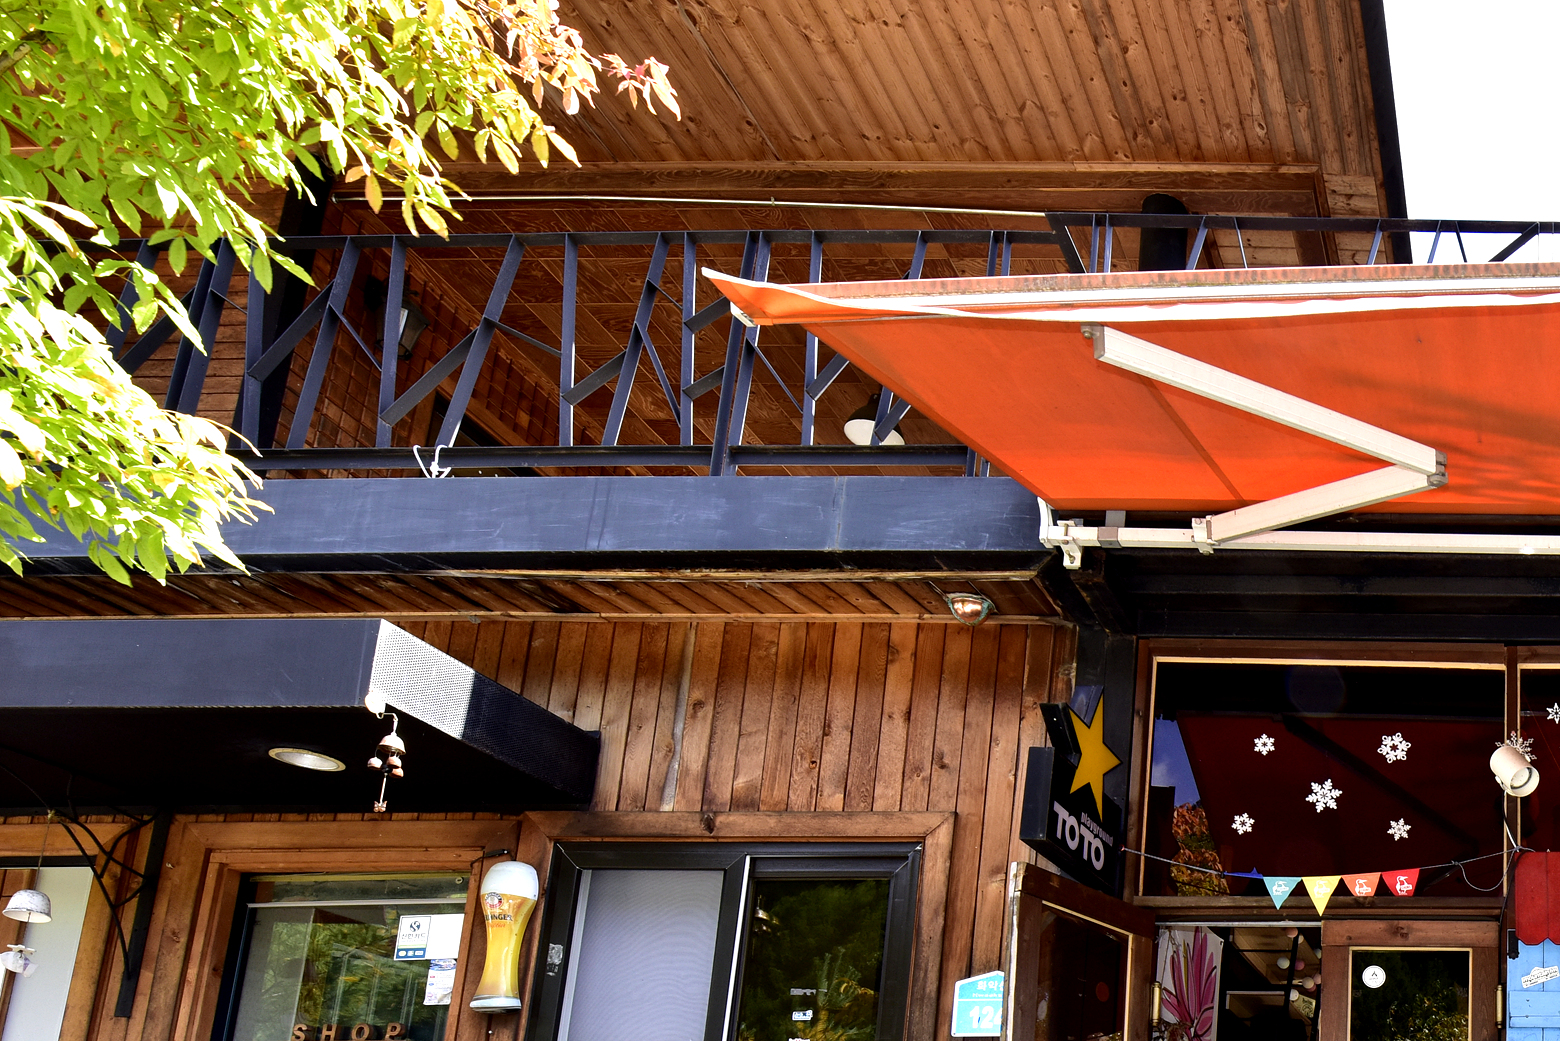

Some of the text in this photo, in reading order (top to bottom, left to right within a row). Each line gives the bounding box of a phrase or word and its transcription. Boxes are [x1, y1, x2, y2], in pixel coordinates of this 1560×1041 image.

[1053, 800, 1105, 871] TOTO
[1080, 811, 1114, 848] playground
[290, 1022, 406, 1041] SHOP
